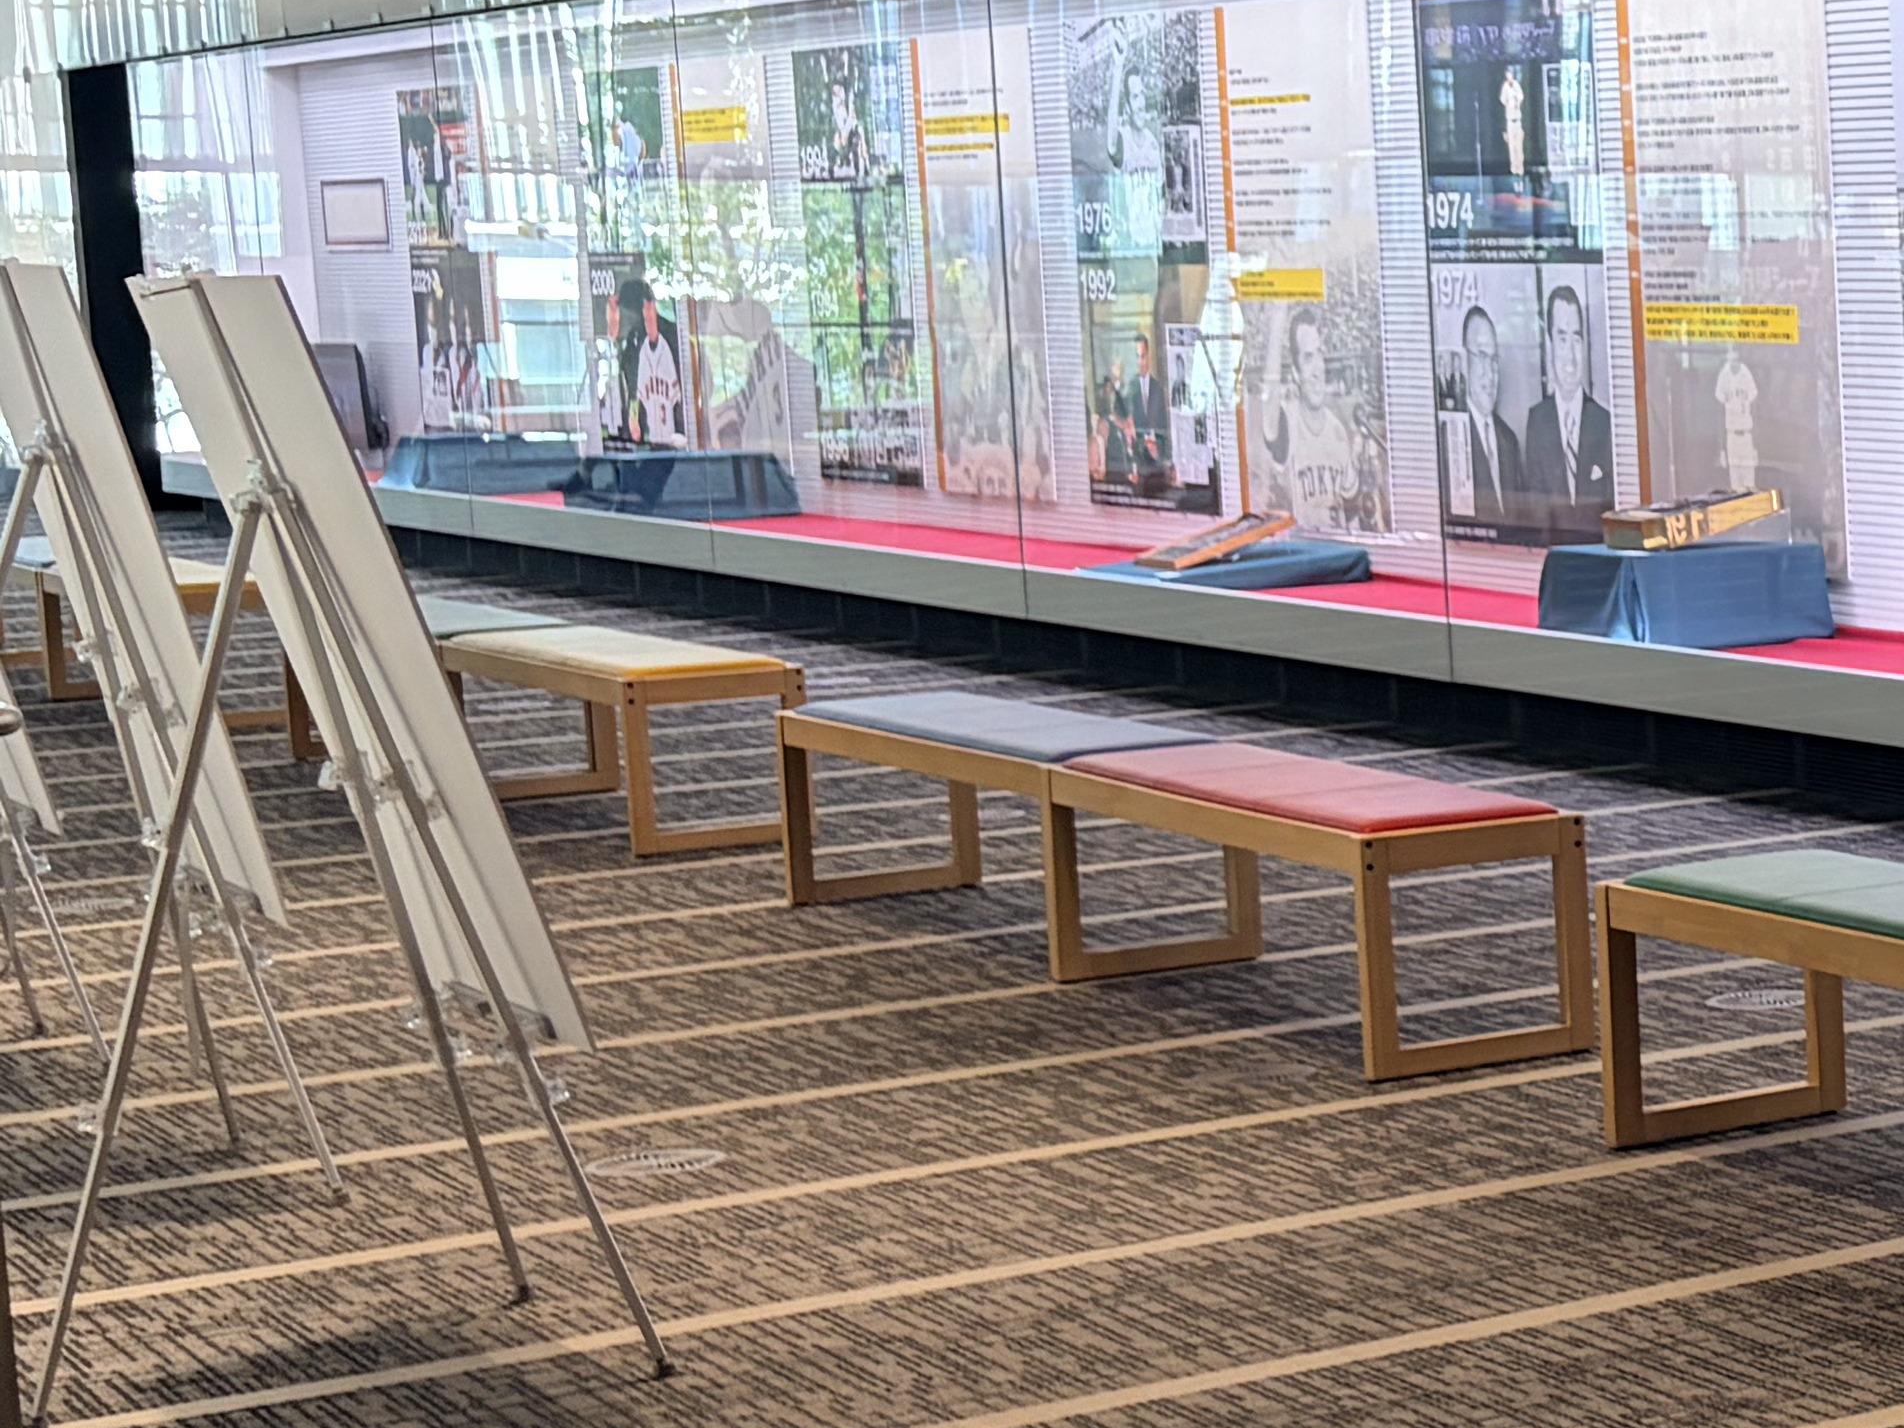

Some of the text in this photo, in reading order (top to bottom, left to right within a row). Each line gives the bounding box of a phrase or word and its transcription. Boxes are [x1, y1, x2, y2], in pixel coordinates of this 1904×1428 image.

[1076, 202, 1112, 235] 1976
[1426, 192, 1475, 230] 1974
[1080, 268, 1118, 301] 1992
[1431, 270, 1480, 306] 1974
